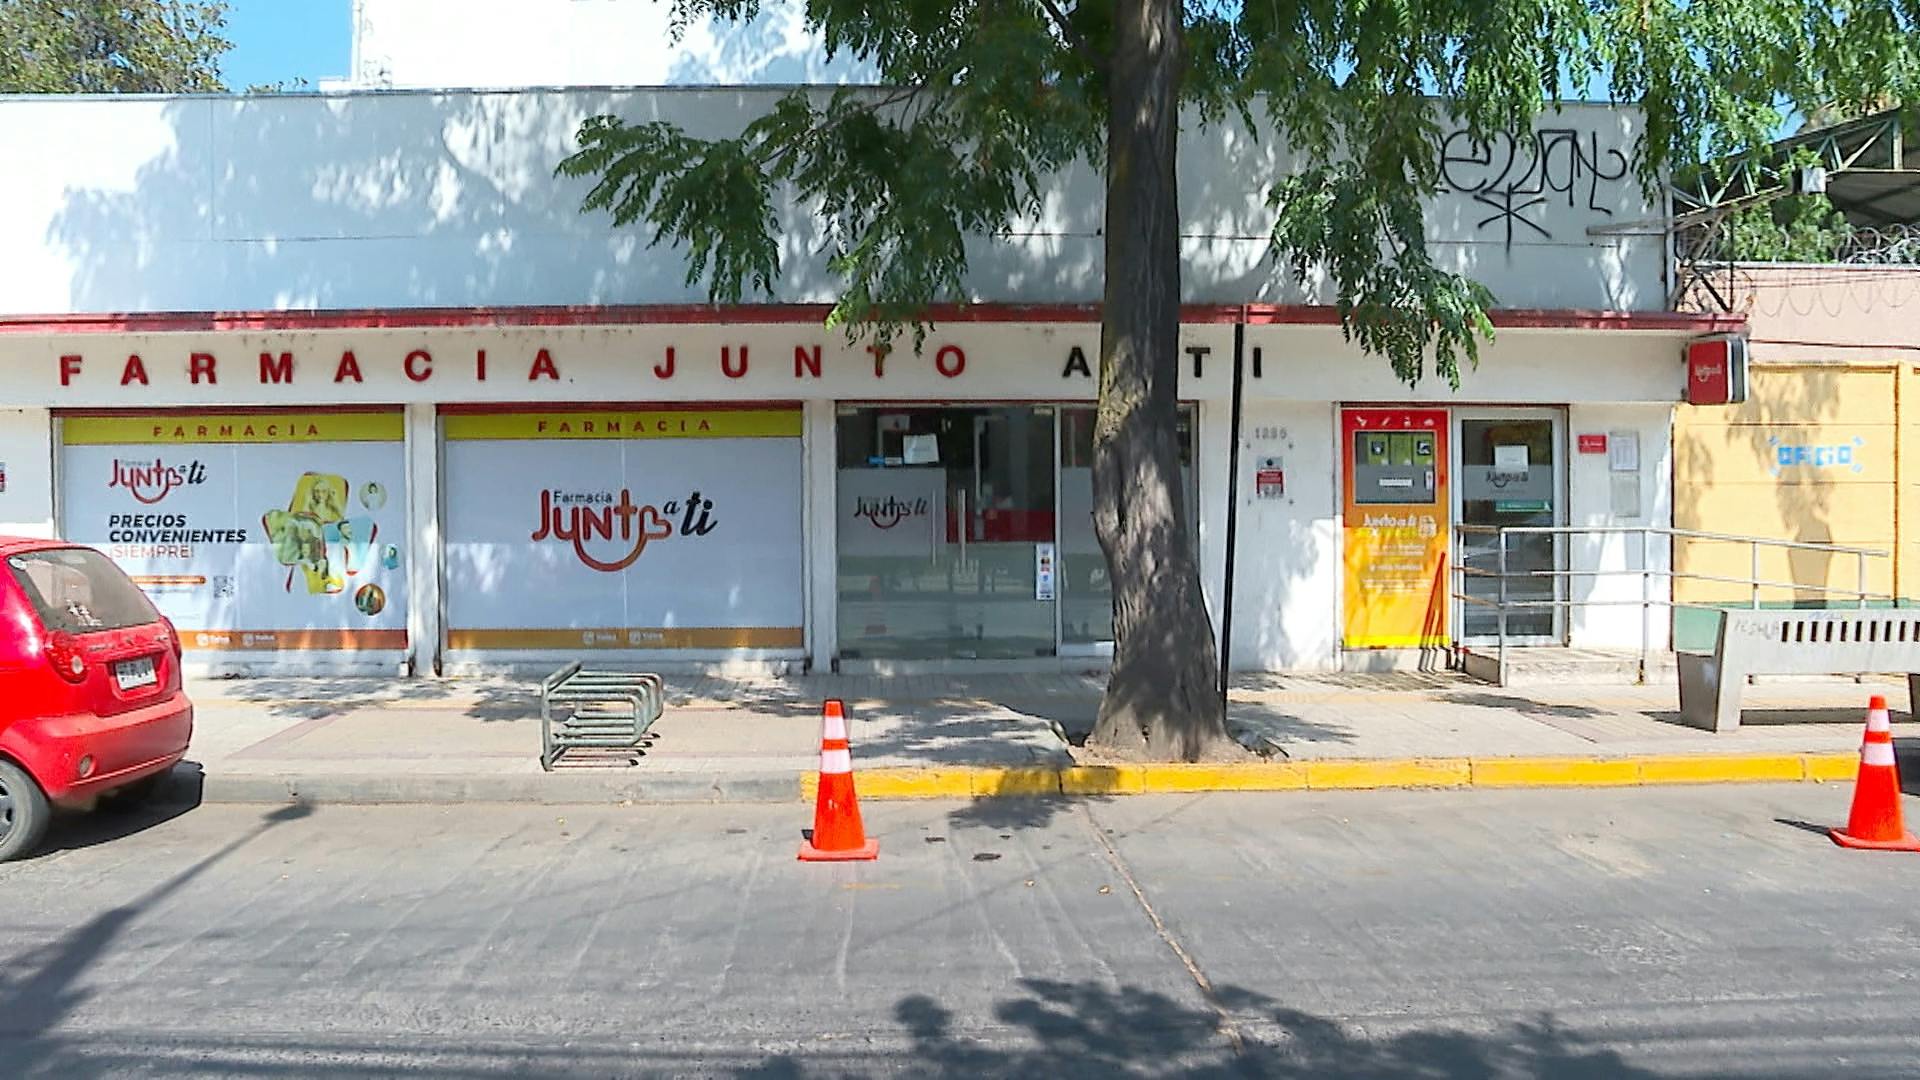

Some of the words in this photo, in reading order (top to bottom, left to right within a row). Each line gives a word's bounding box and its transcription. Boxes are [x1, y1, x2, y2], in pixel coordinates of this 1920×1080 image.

[59, 348, 560, 386] FARMACIA
[653, 345, 966, 380] JUNTO
[1062, 346, 1092, 378] A
[1185, 346, 1262, 378] TI
[153, 423, 320, 438] FARMACIA
[537, 418, 712, 433] FARMACIA
[553, 491, 613, 504] Farmacia
[680, 491, 718, 536] ti
[109, 515, 187, 528] PRECIOS
[109, 529, 247, 543] CONVENIENTES
